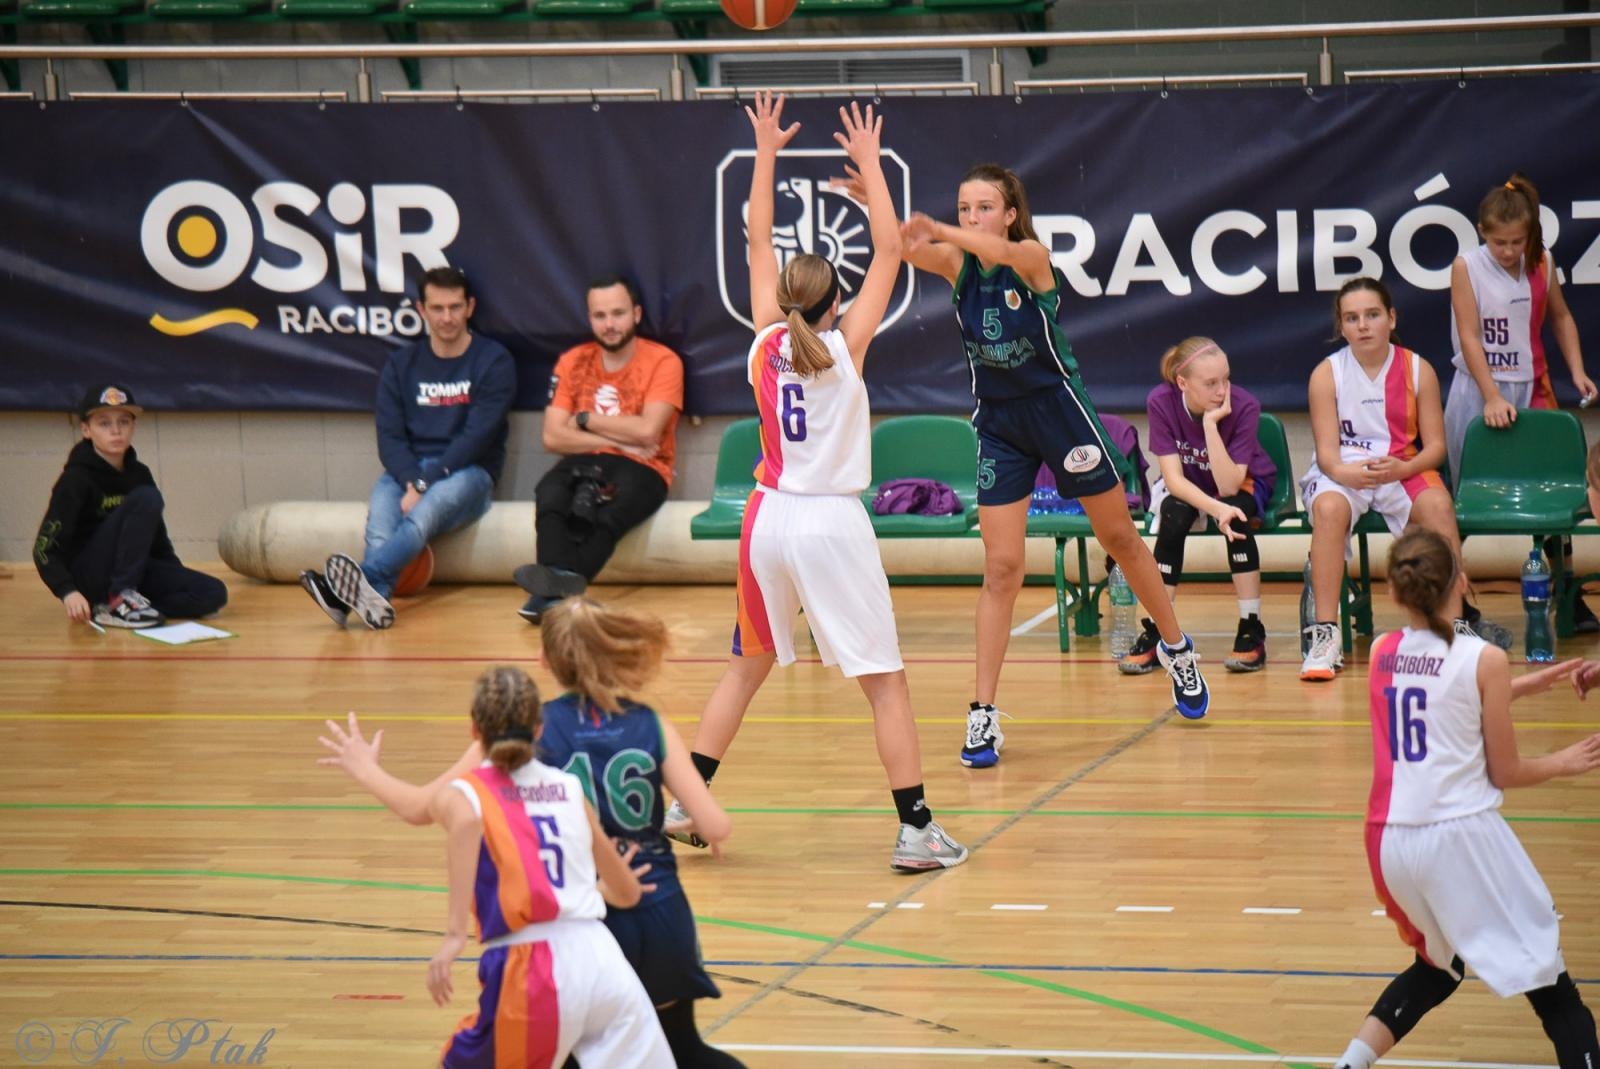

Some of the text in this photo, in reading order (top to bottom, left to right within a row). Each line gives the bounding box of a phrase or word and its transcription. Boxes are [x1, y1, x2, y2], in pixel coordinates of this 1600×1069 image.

[141, 180, 460, 292] OSiR
[277, 299, 431, 336] RACIBÓ
[983, 307, 1002, 340] 5
[1483, 317, 1509, 345] 55
[418, 380, 471, 398] TOMMY
[782, 383, 807, 442] 6
[979, 458, 996, 490] 5
[1383, 687, 1428, 762] 16
[561, 748, 656, 831] 16
[530, 815, 564, 889] 5
